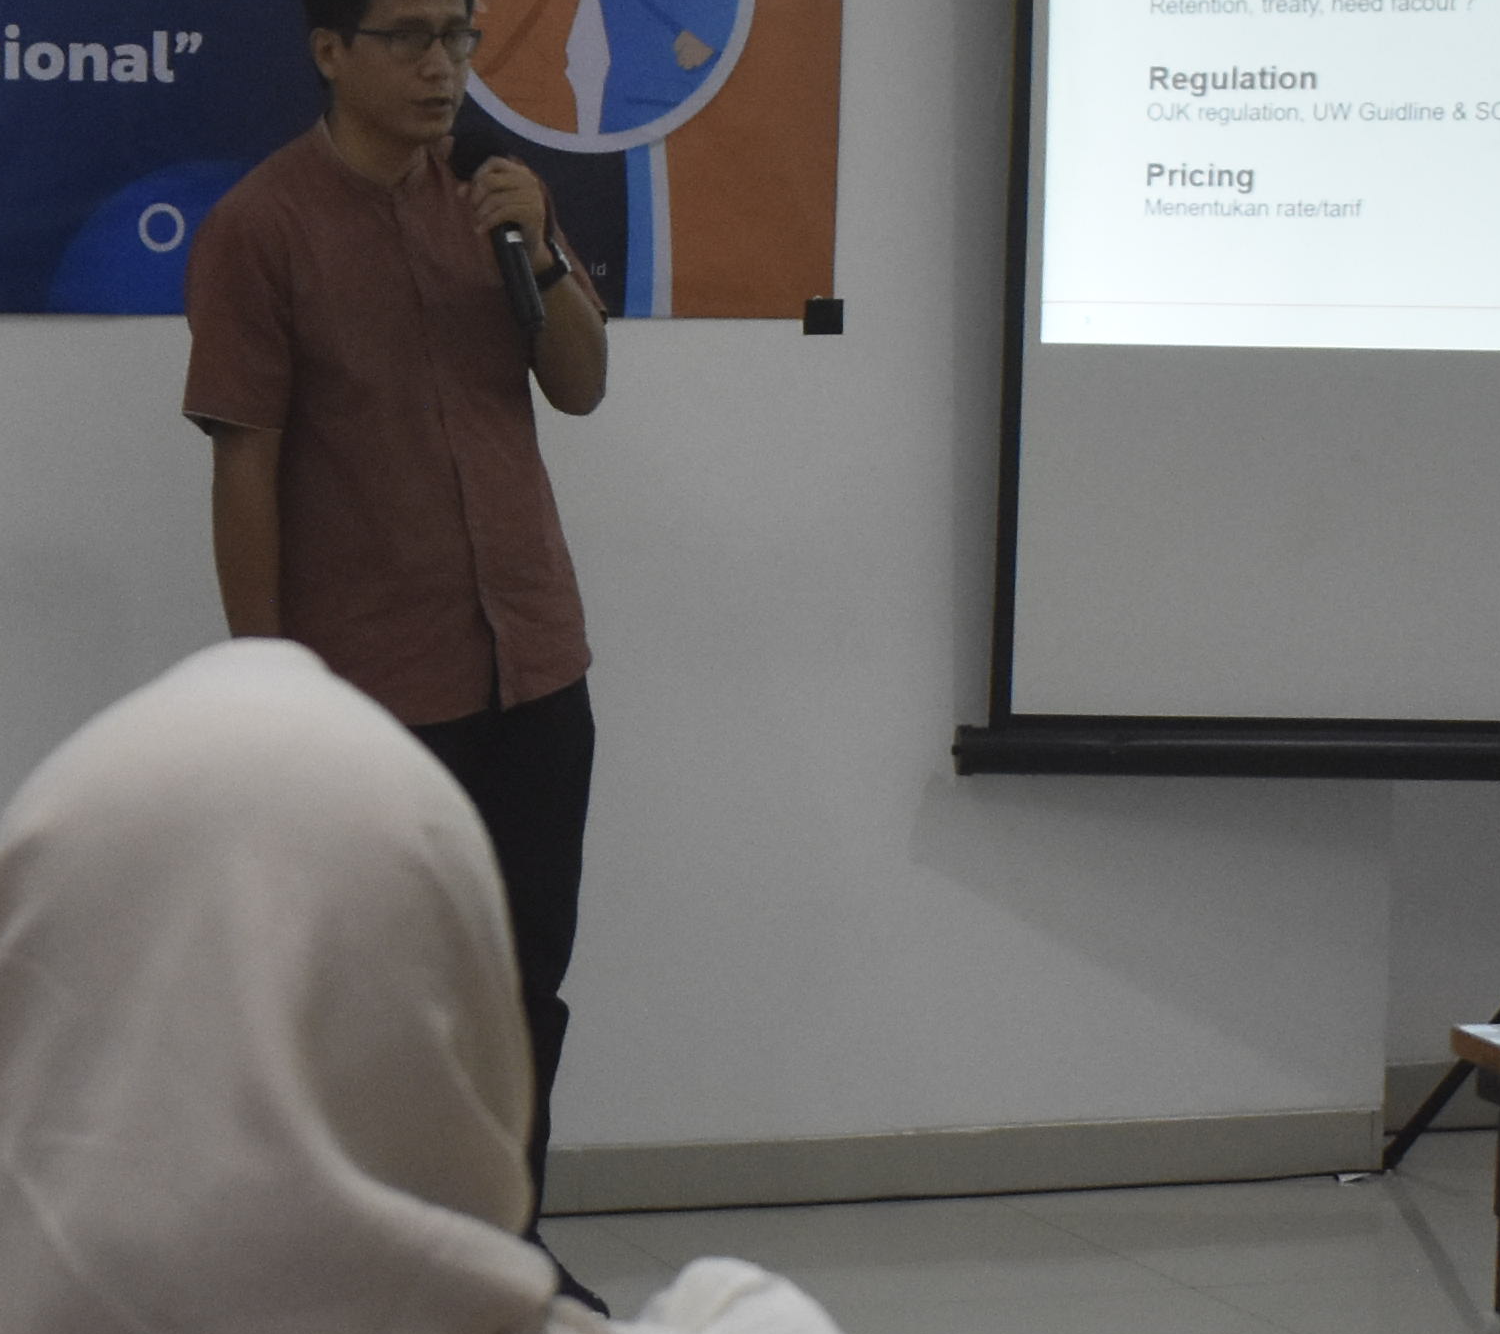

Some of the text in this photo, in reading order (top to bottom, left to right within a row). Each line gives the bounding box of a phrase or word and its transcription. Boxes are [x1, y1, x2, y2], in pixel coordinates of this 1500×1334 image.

[1149, 66, 1318, 98] Regulation
[1147, 103, 1191, 122] OJK
[1313, 102, 1353, 122] UW
[1358, 102, 1446, 122] Guidline
[1452, 102, 1467, 121] &
[1146, 162, 1255, 195] Pricing
[1145, 198, 1363, 219] Menentukan rate/tarif
